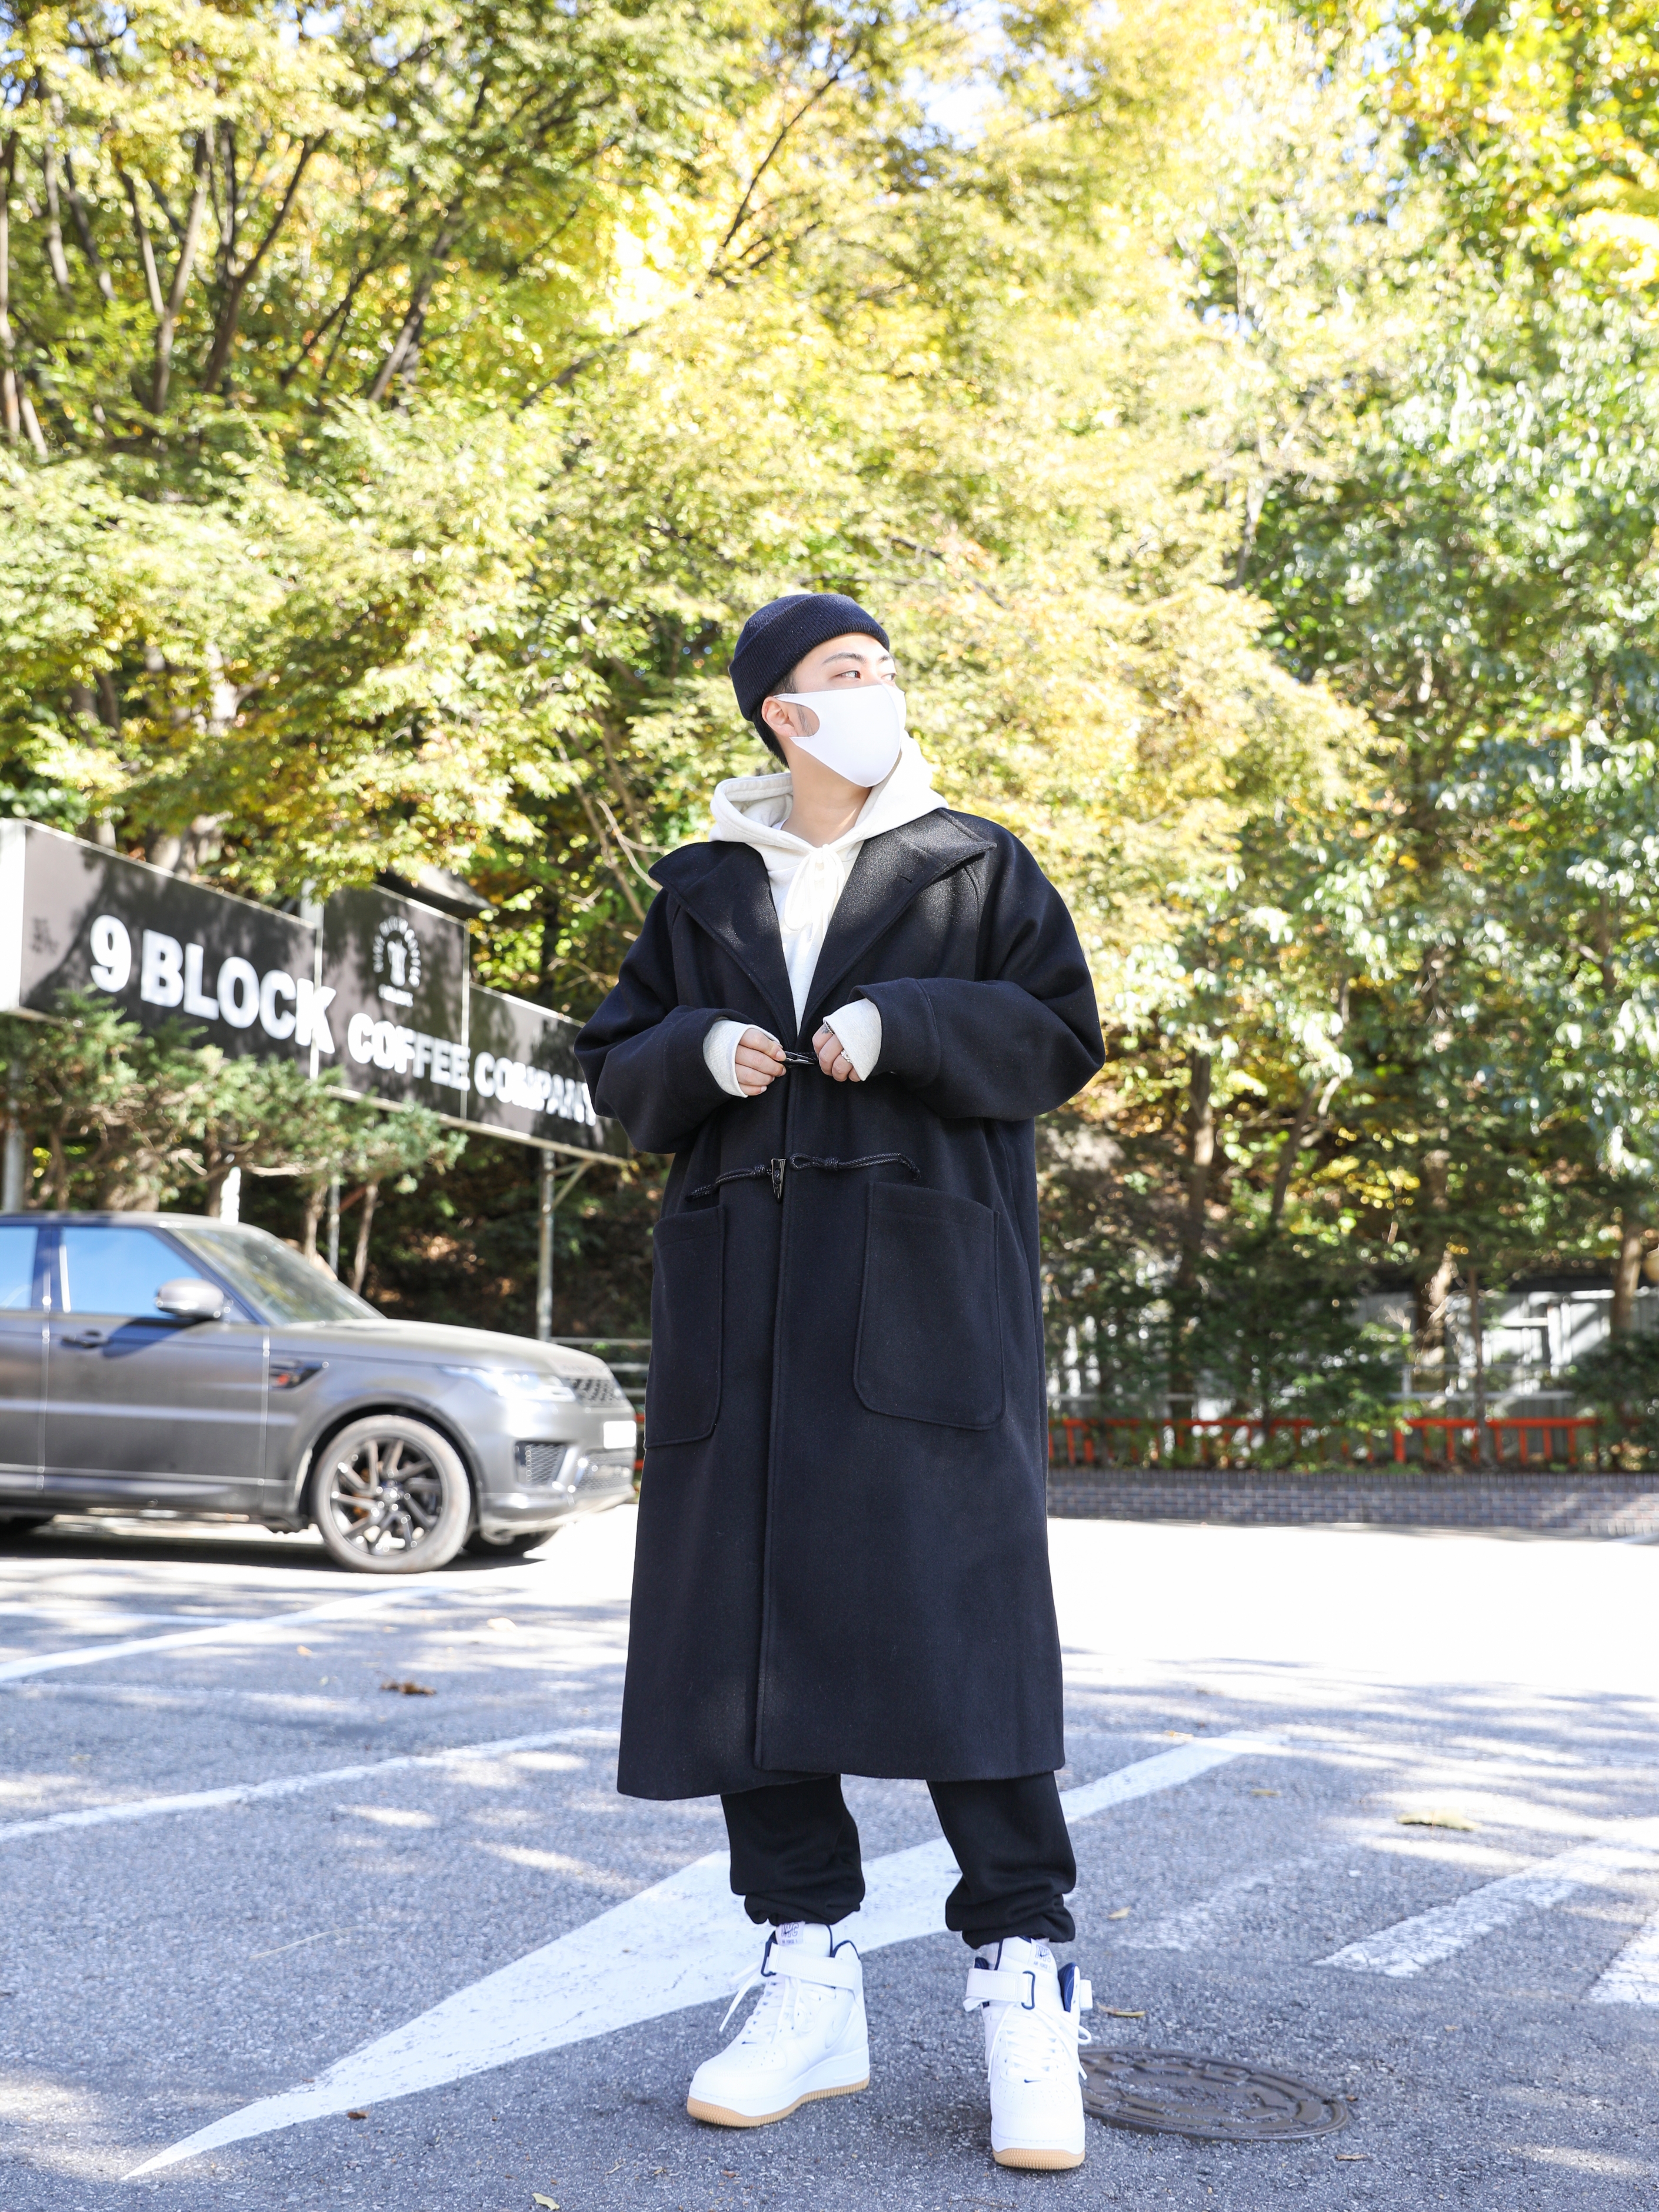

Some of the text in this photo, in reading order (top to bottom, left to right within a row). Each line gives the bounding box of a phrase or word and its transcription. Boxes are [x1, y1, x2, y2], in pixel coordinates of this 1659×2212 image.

[90, 914, 132, 993] 9
[141, 928, 337, 1054] BLOCK
[348, 1012, 470, 1091] COFFEE
